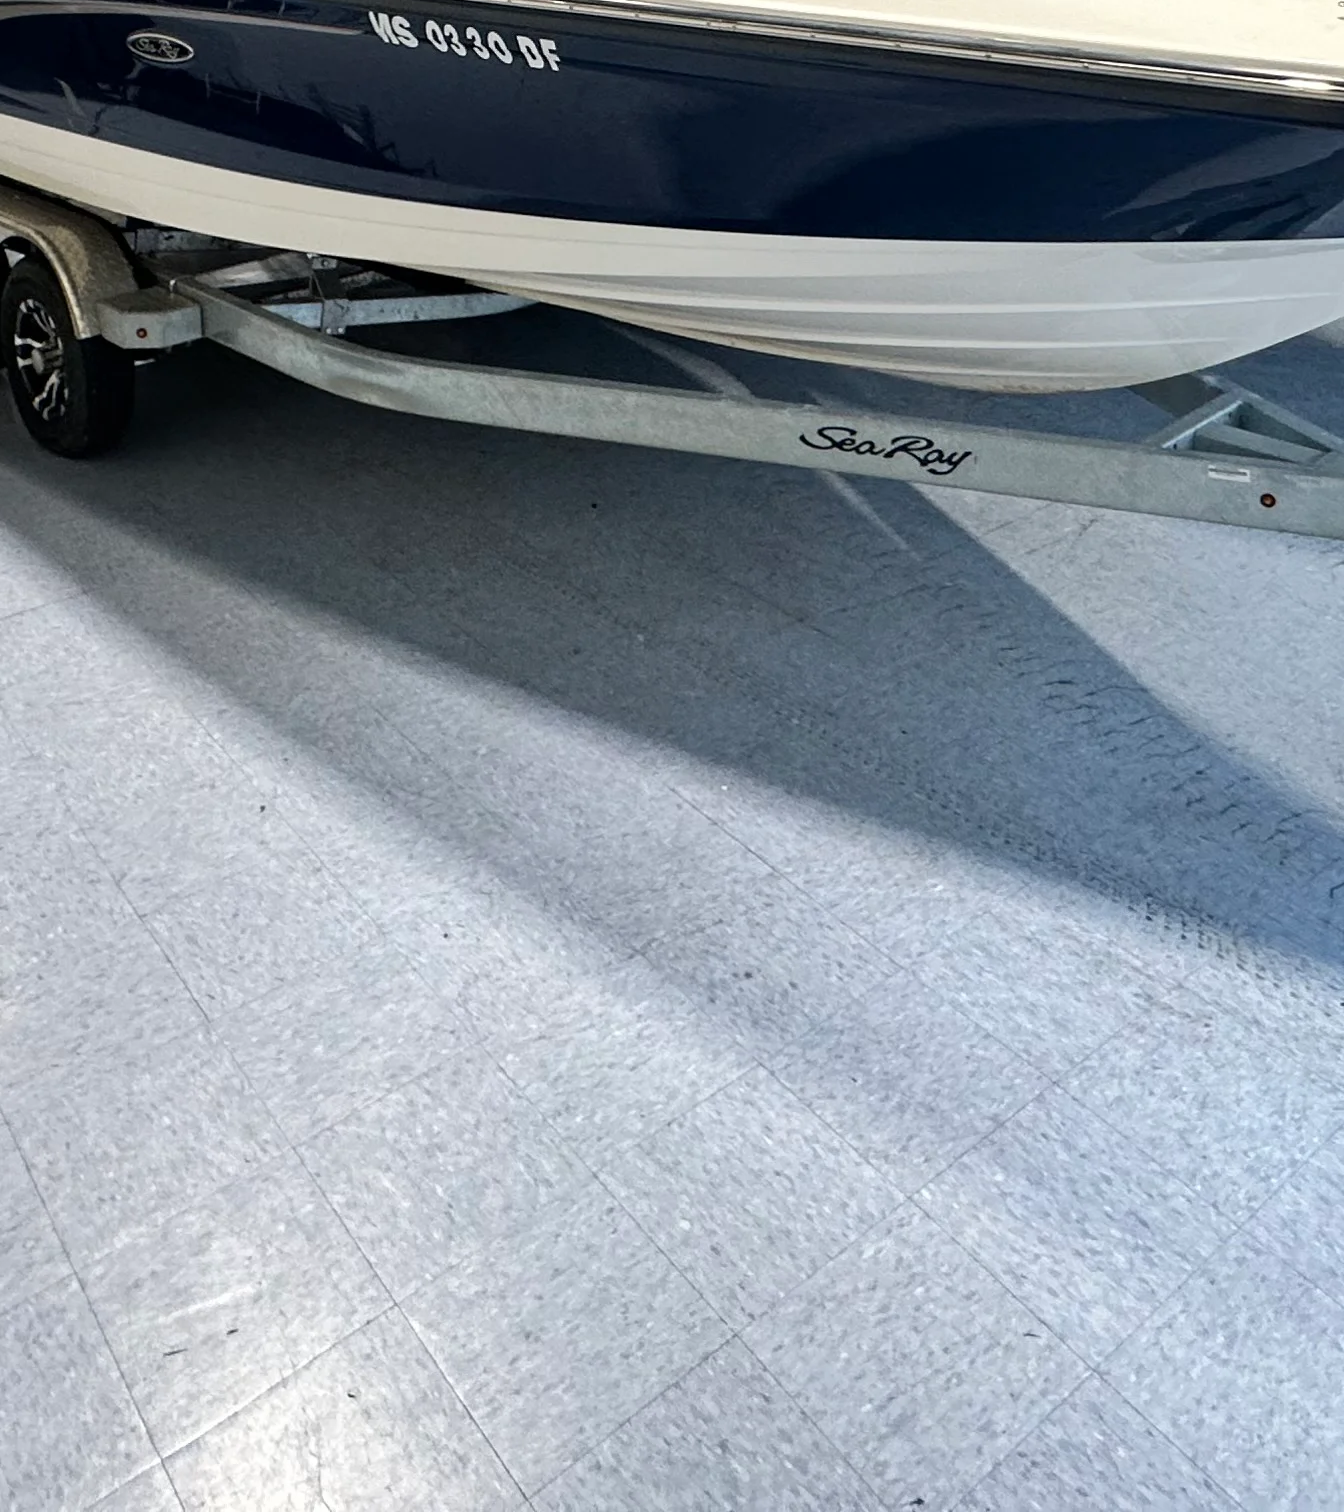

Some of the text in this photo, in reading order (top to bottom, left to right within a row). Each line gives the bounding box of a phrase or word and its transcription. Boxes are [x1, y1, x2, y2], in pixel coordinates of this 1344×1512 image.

[516, 35, 561, 71] DF
[799, 426, 972, 475] Sea Ray
